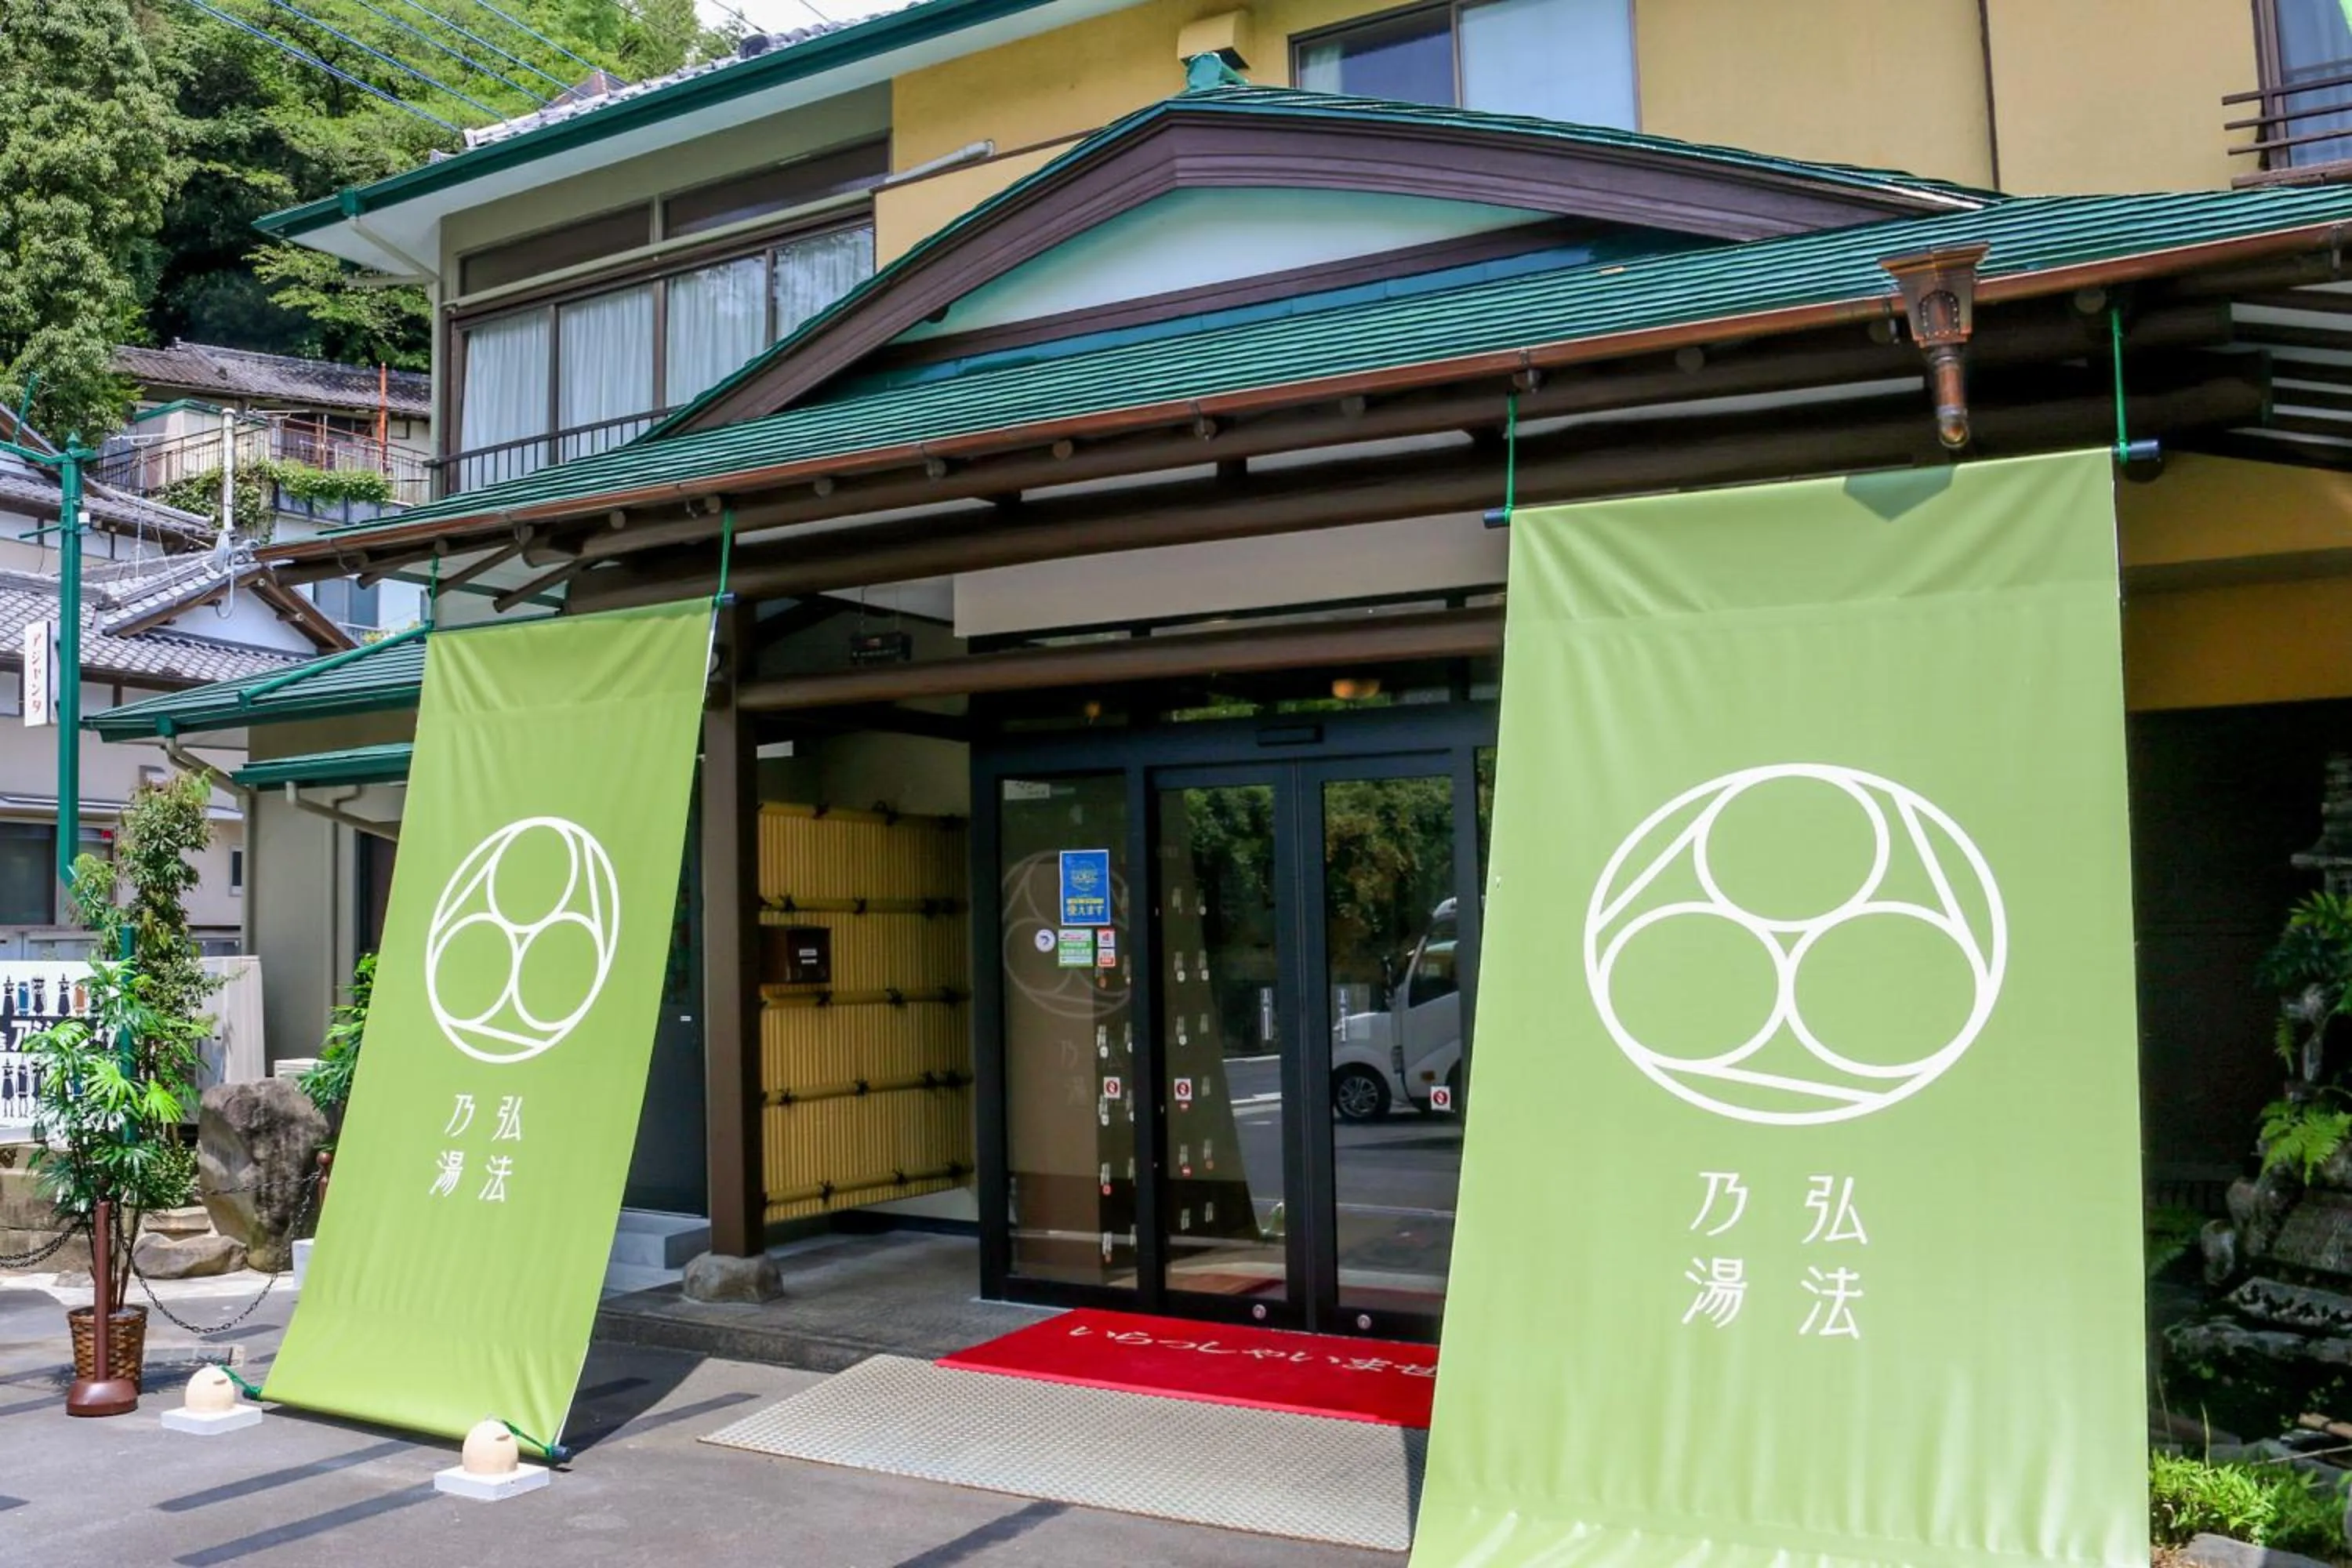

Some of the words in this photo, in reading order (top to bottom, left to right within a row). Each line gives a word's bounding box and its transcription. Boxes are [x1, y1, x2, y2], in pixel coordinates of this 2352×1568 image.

[31, 631, 42, 713] アジャンタ
[429, 1094, 476, 1197] 乃湯
[478, 1094, 523, 1203] 弘法
[1681, 1171, 1749, 1329] 乃湯
[1798, 1174, 1869, 1340] 弘法
